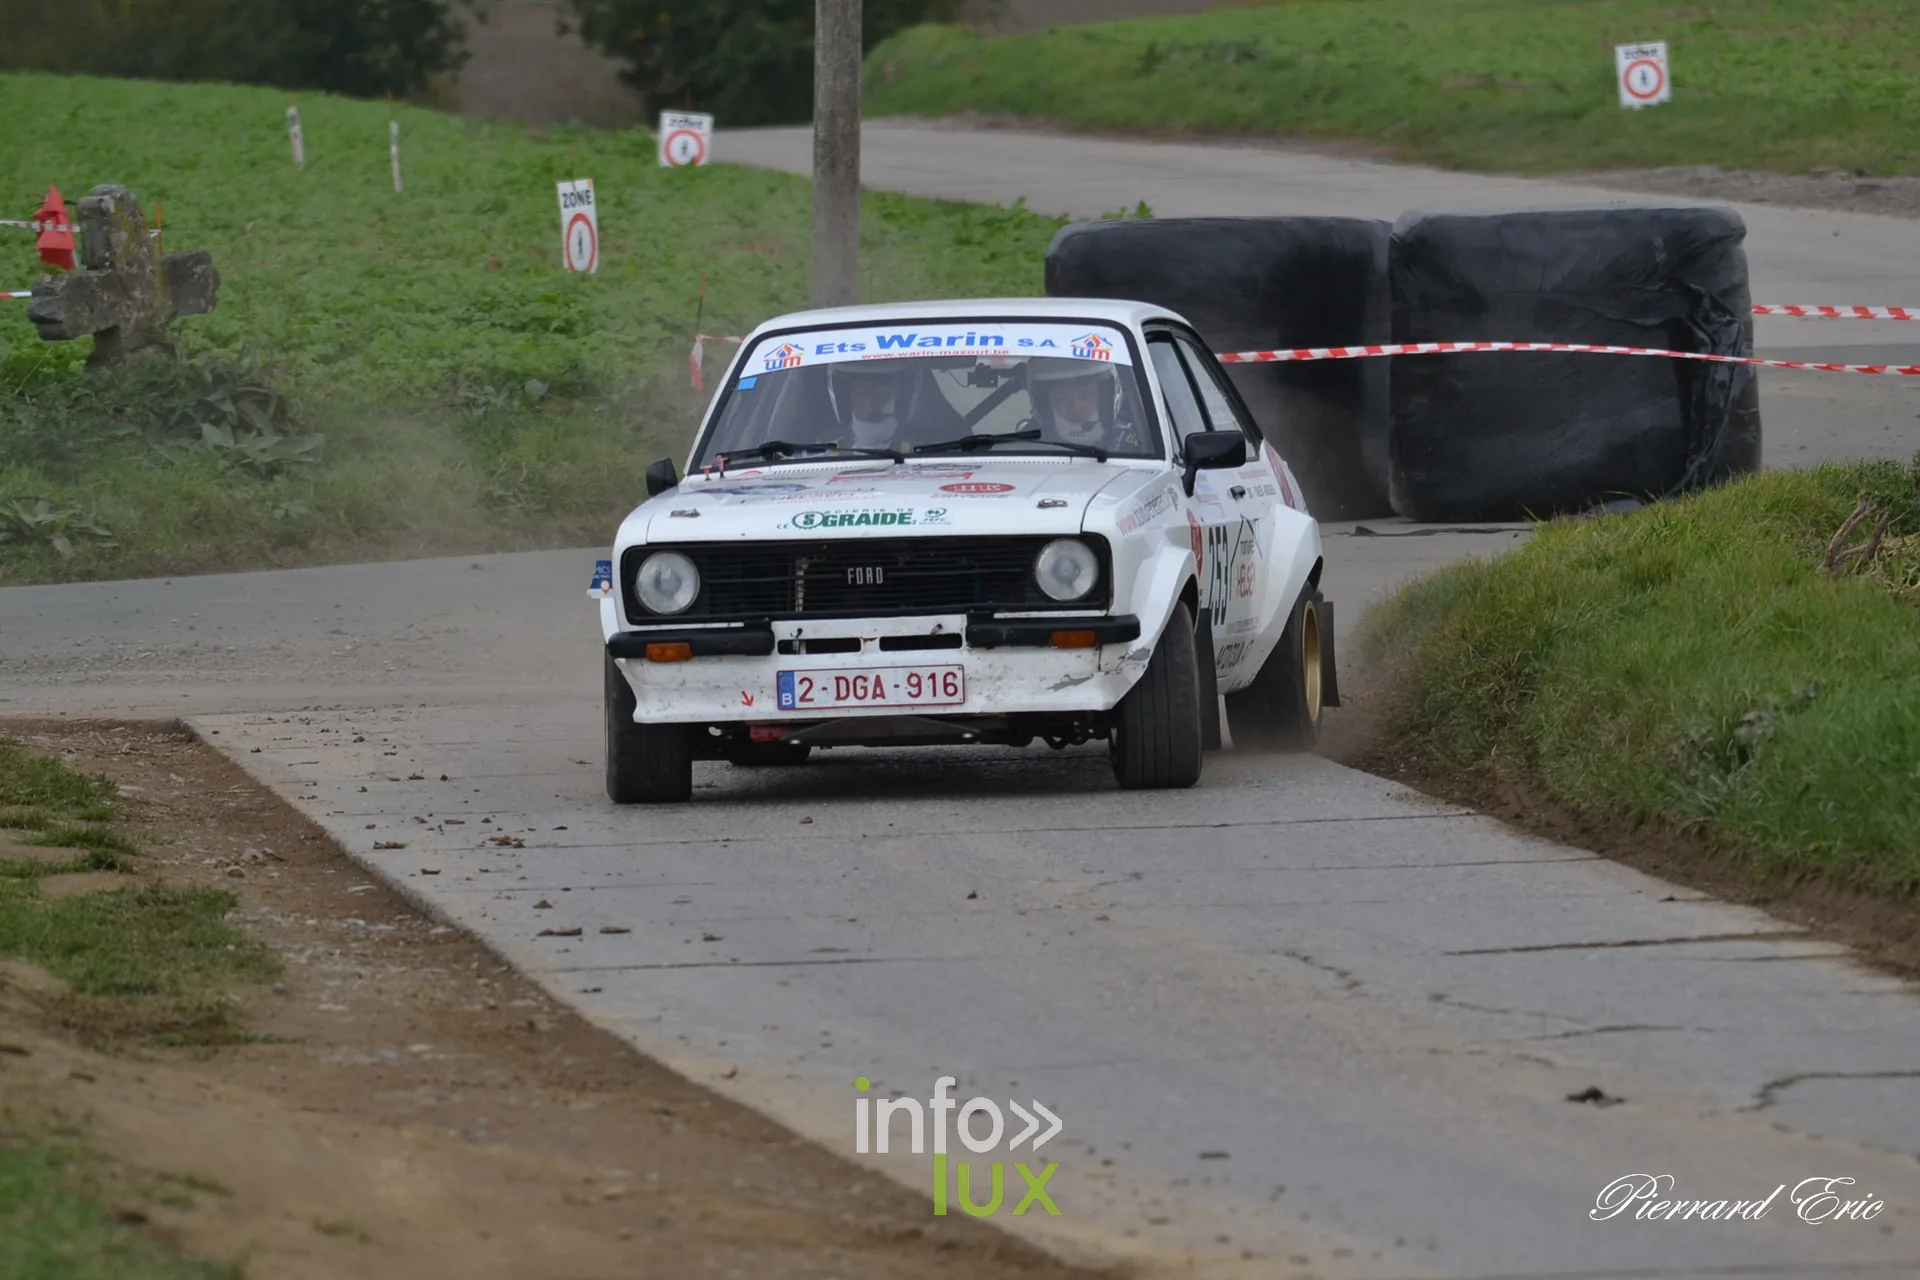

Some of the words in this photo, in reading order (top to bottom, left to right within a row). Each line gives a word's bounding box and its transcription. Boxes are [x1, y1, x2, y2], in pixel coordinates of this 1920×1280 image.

[562, 190, 592, 208] ZONE
[816, 342, 866, 355] Ets
[876, 332, 1004, 349] Warin
[822, 512, 912, 527] GRAIDE
[848, 566, 884, 585] FORD
[1208, 525, 1228, 626] 253
[798, 671, 958, 703] 2-DGA-916
[782, 693, 793, 706] B
